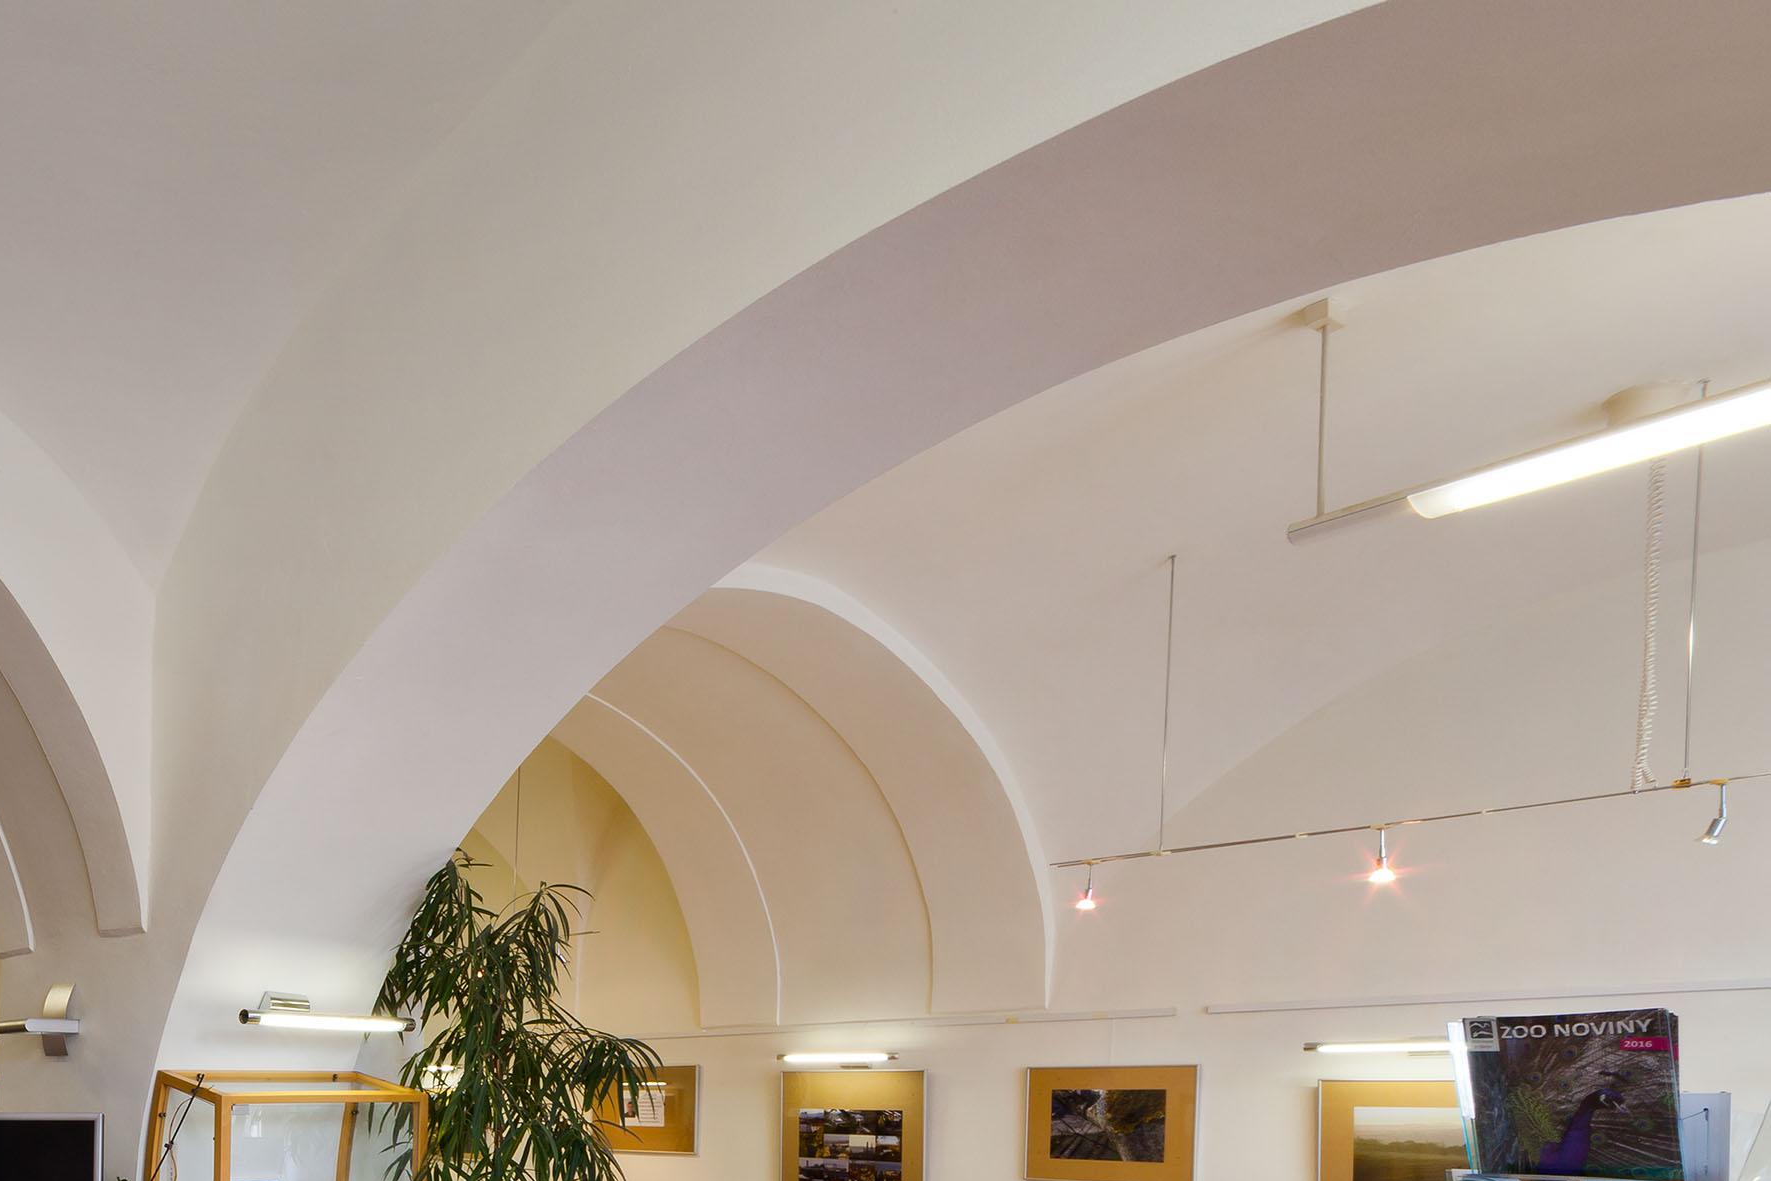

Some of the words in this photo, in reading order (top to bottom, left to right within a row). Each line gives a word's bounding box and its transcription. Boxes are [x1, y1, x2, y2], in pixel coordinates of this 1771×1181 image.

[1500, 1024, 1547, 1040] ZOO
[1554, 1018, 1652, 1038] NOVINY
[1623, 1040, 1653, 1048] 2016
